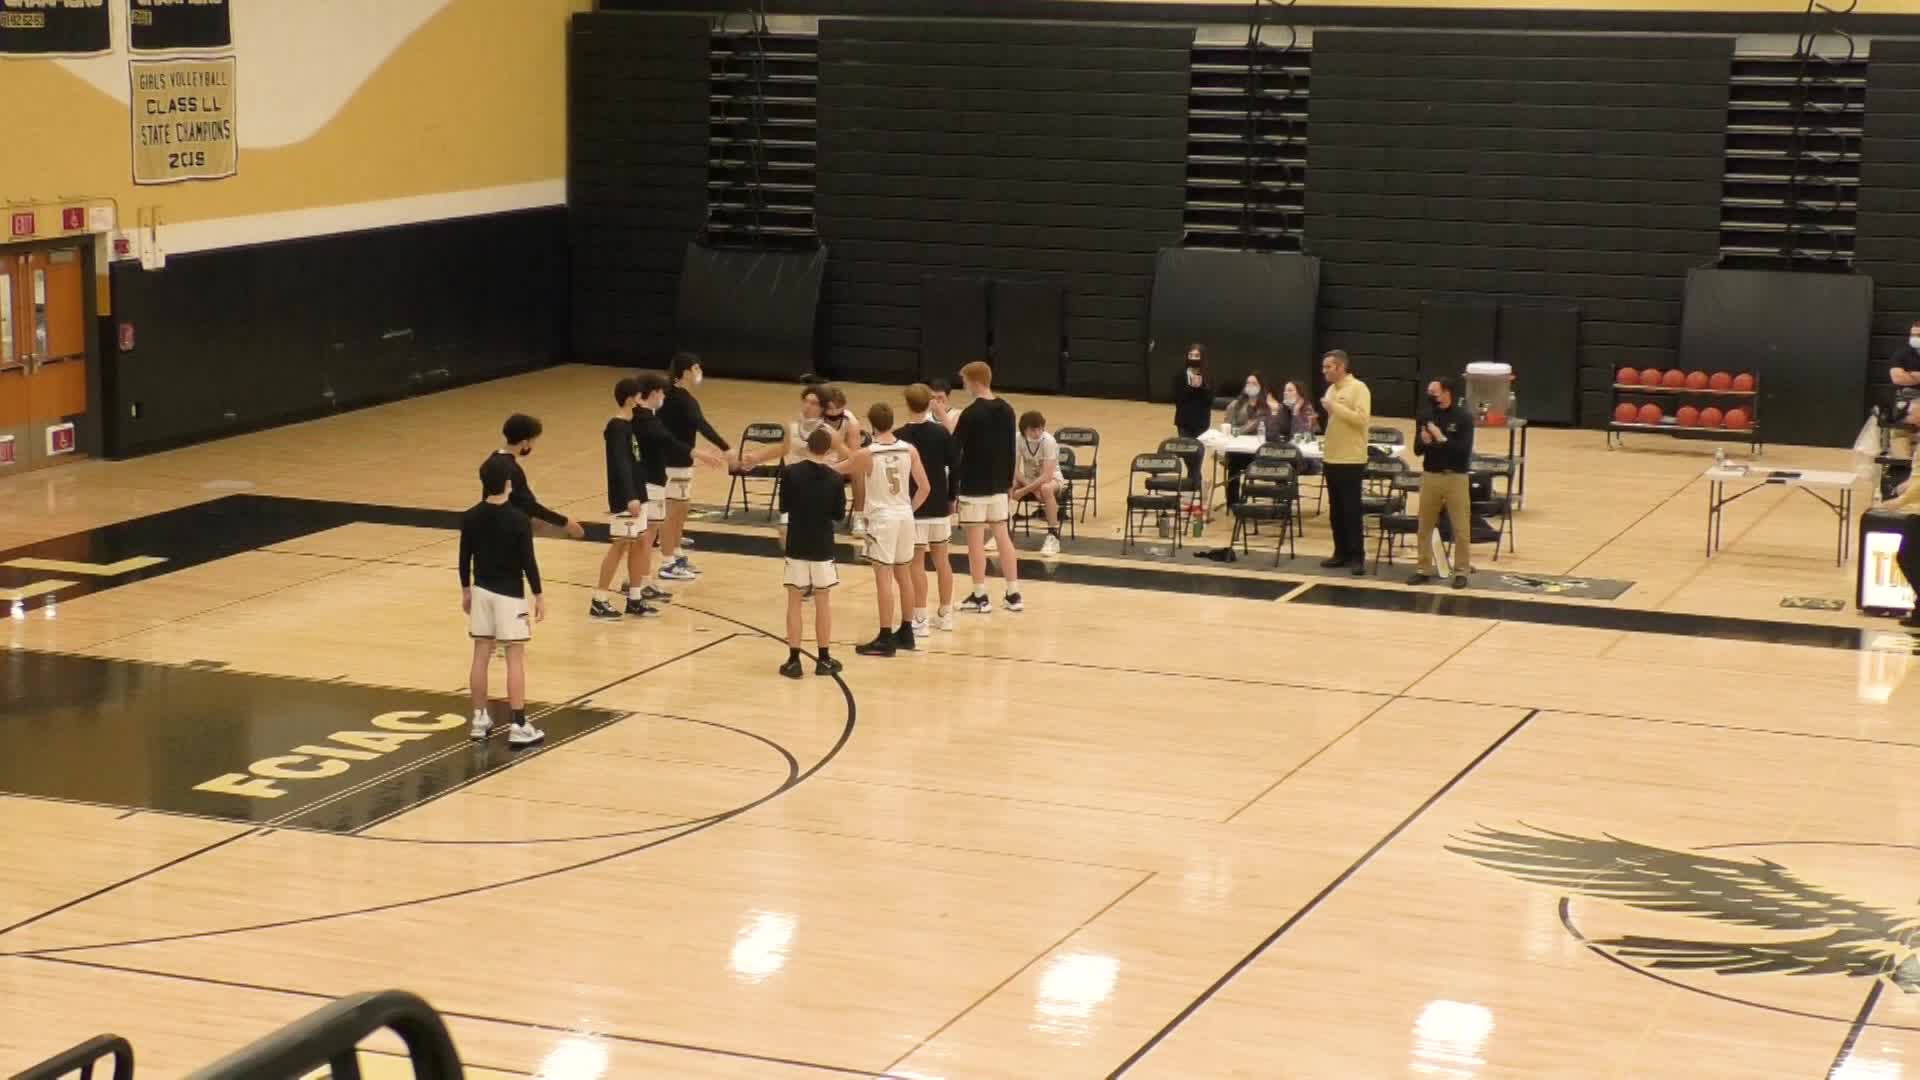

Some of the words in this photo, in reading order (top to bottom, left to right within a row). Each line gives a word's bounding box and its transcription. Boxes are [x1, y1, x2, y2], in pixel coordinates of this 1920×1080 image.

[170, 71, 228, 88] VOLLEYBALL
[146, 96, 198, 114] CLASS
[202, 96, 222, 112] LL
[141, 124, 171, 146] STATE
[176, 119, 230, 142] CHAMPIONS
[192, 710, 467, 799] FCIAC
